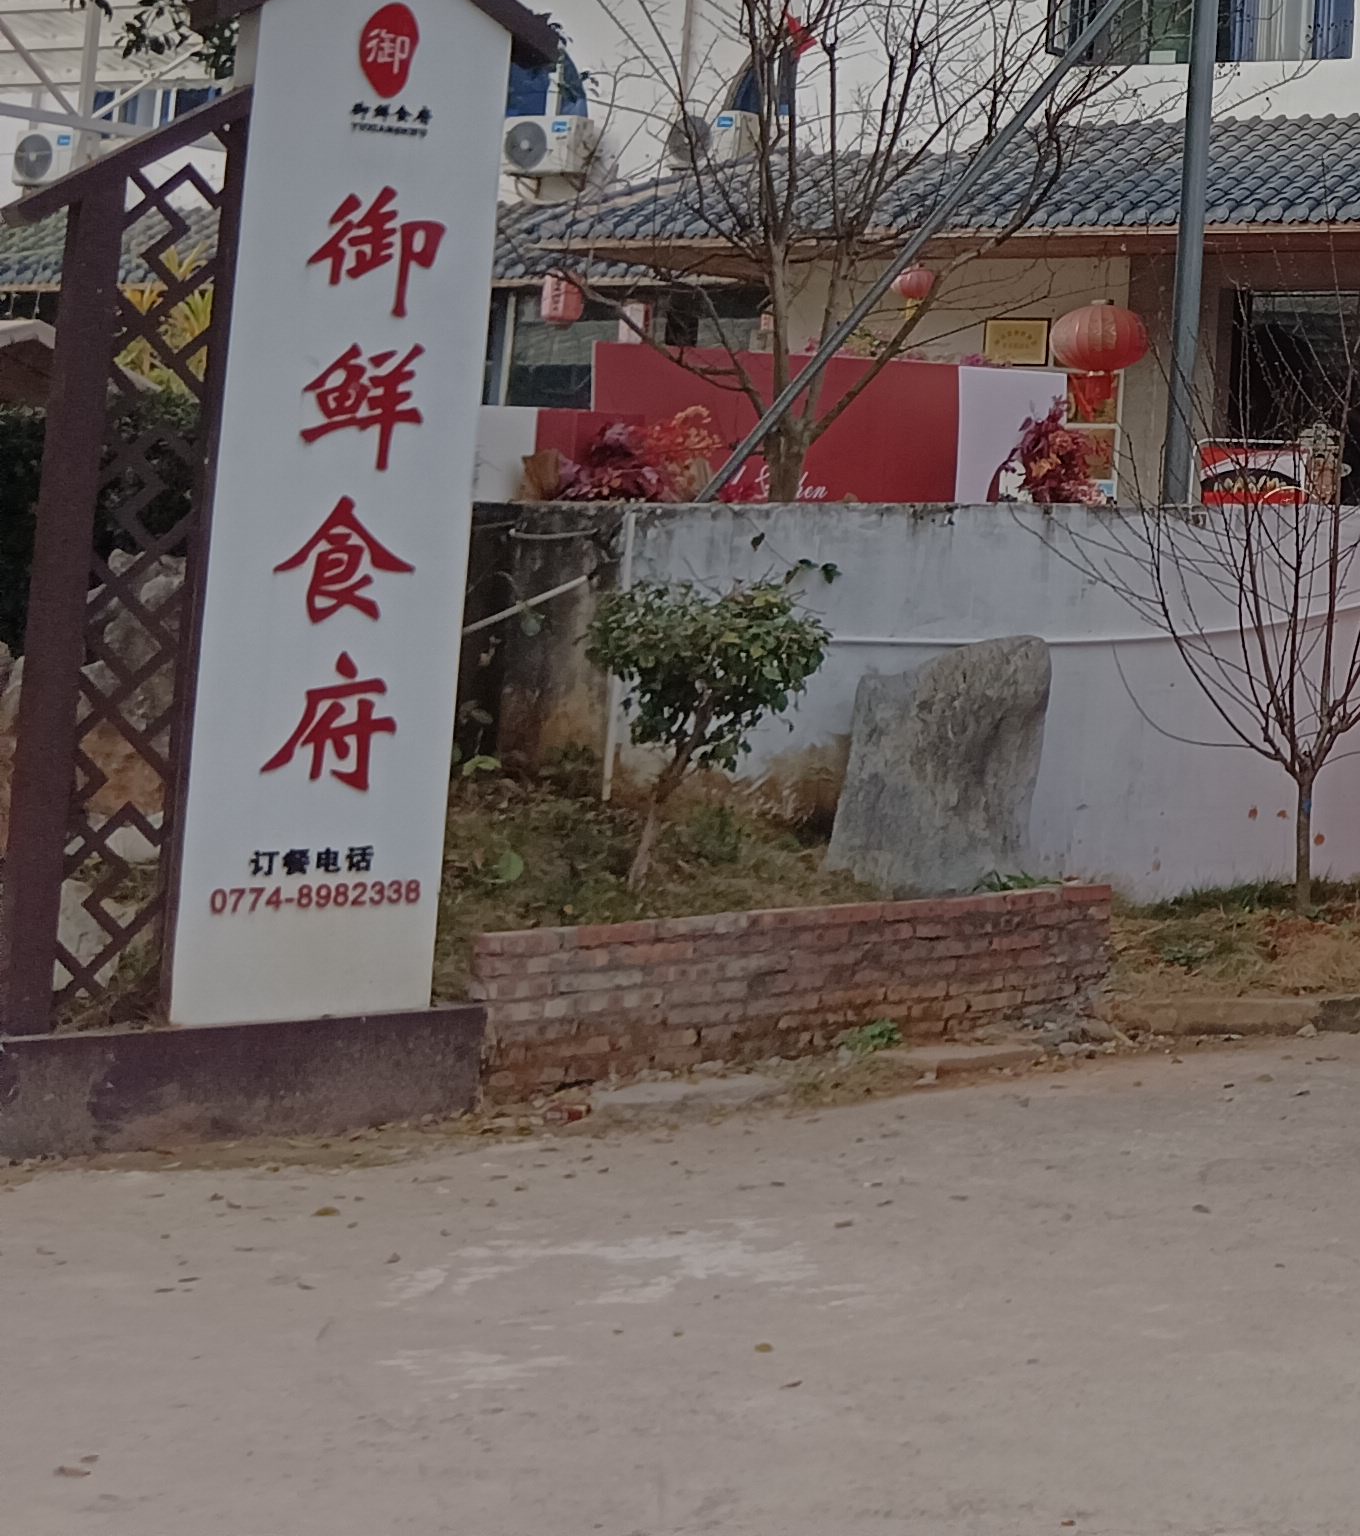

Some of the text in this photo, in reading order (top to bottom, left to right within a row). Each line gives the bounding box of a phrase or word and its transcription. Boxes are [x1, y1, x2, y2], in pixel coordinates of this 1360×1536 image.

[365, 28, 411, 75] 御
[260, 186, 447, 792] 御鲜食府
[249, 844, 375, 877] 订餐电话
[209, 879, 421, 916] 0774-8982338
